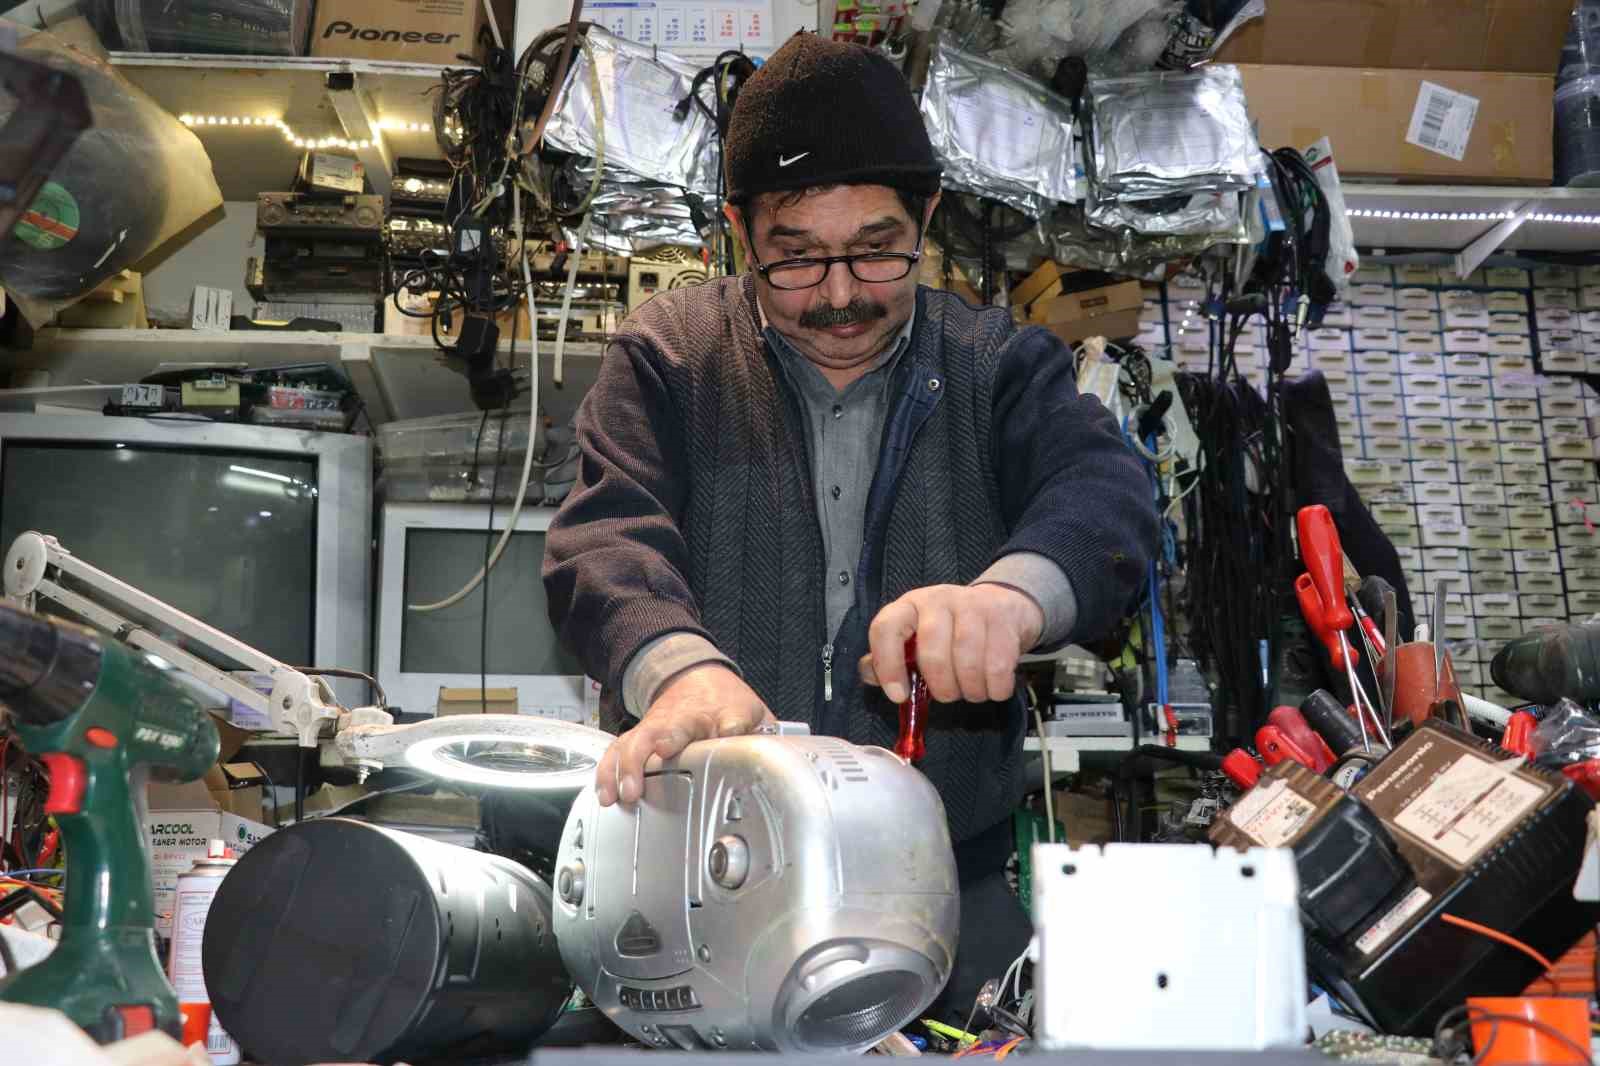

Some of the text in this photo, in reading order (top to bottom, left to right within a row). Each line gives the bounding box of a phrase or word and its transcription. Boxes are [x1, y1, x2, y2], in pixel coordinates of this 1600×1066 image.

[323, 21, 461, 44] Pioneer
[1366, 741, 1435, 801] Panasonic
[178, 837, 208, 847] MOTOR
